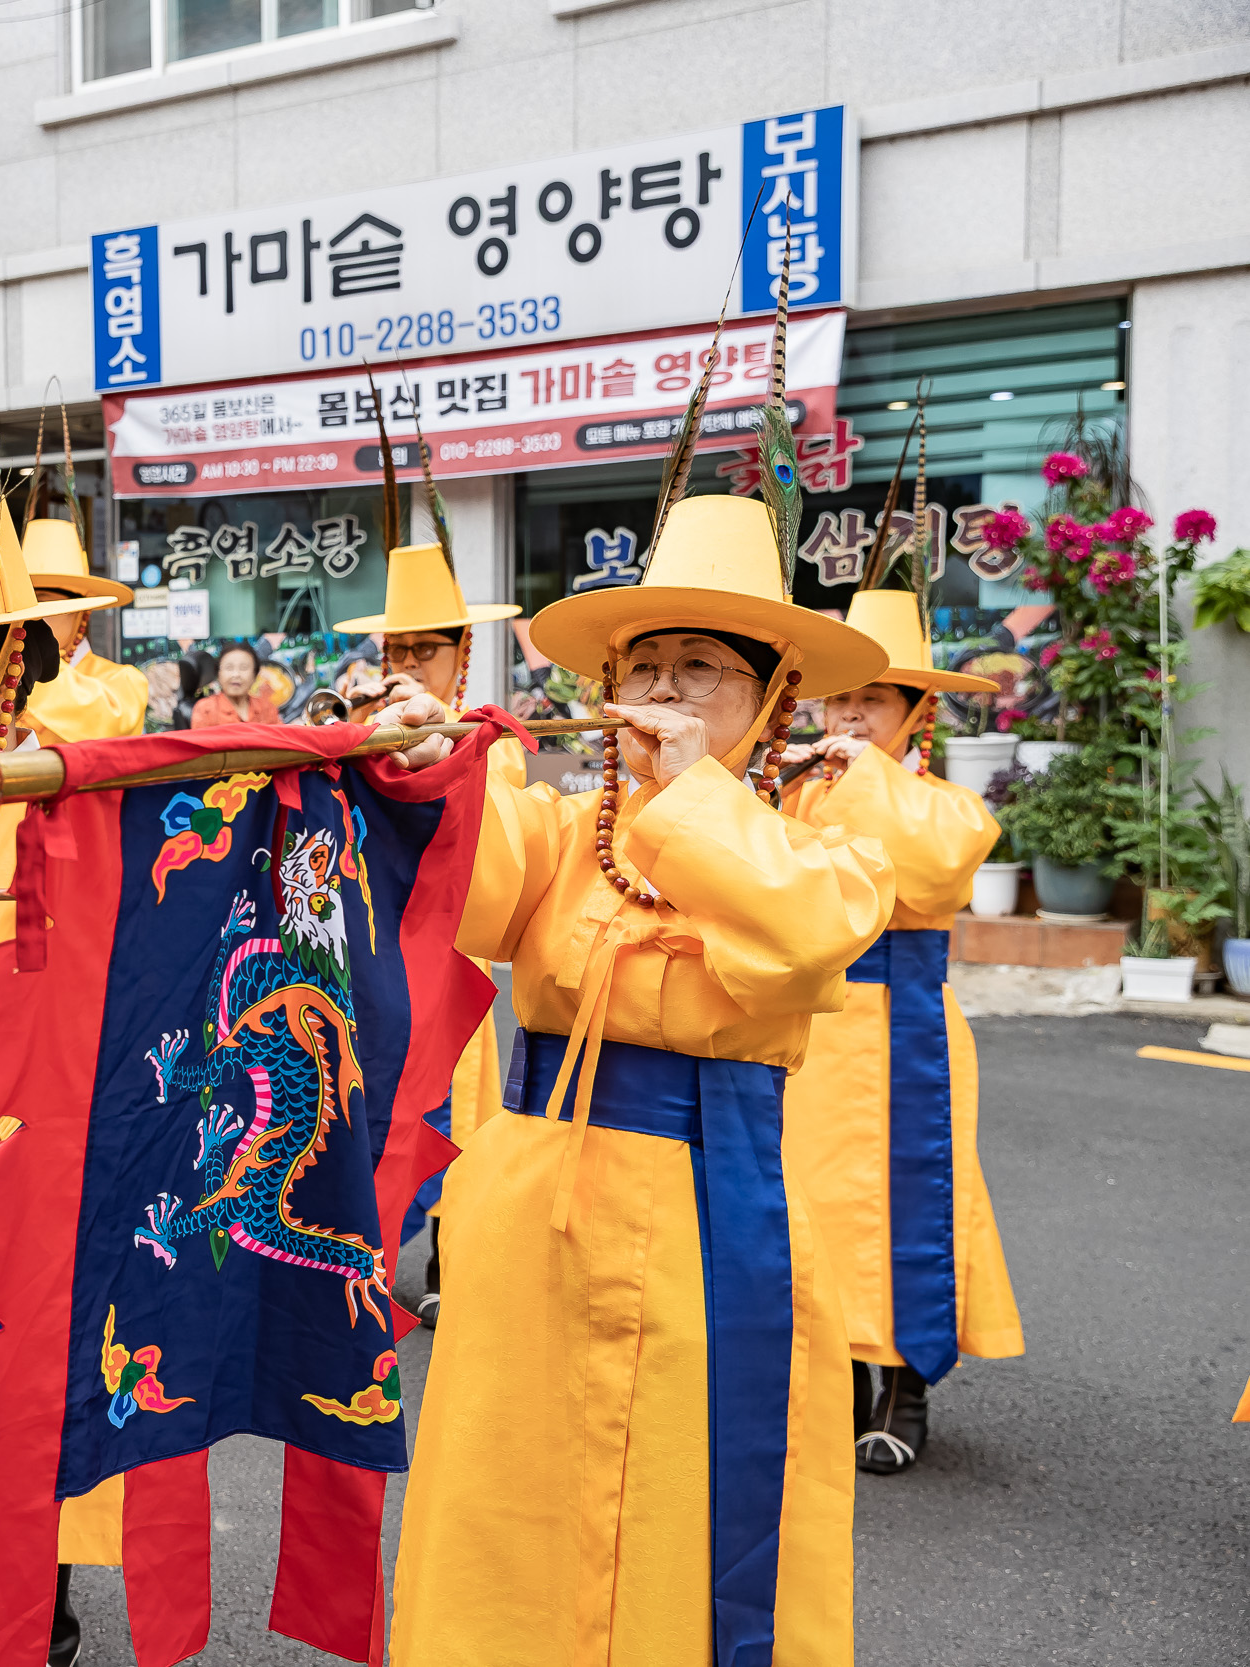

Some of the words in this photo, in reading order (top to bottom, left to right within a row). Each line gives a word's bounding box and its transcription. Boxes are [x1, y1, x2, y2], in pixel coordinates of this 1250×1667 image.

[174, 213, 403, 313] 가마솥
[448, 152, 722, 276] 영양탕
[761, 111, 825, 301] 보신탕
[103, 233, 147, 384] 흑염소
[301, 295, 562, 360] 010-2288-3533
[160, 402, 206, 424] 365일
[318, 383, 421, 429] 몸보신
[437, 373, 507, 416] 맛집
[520, 358, 636, 405] 가마솥
[162, 425, 207, 446] 가마솥
[163, 514, 367, 584] 흑염소탕
